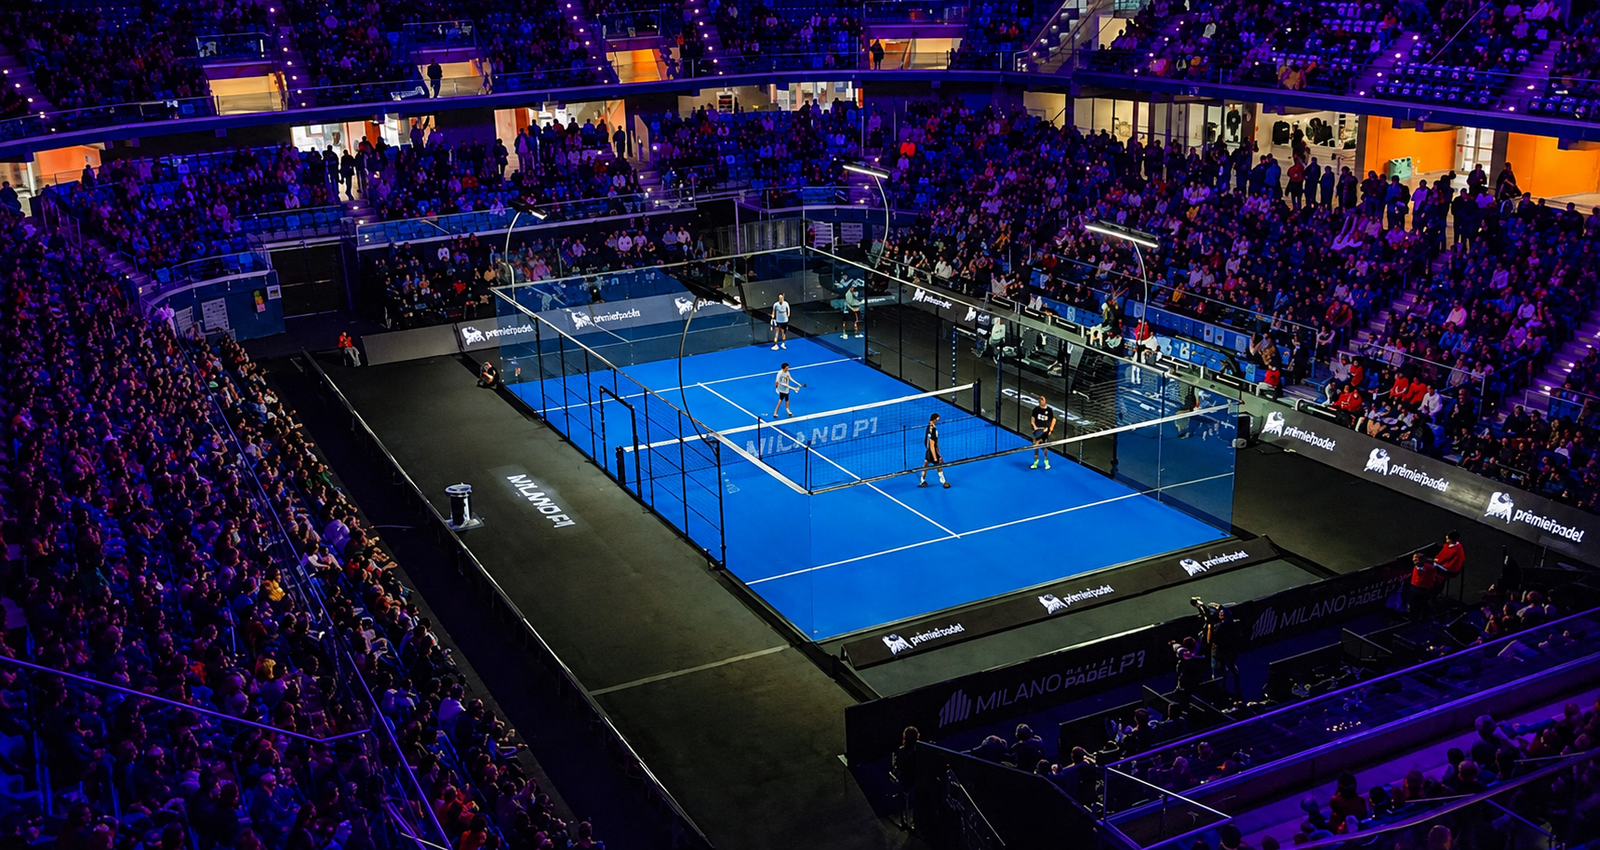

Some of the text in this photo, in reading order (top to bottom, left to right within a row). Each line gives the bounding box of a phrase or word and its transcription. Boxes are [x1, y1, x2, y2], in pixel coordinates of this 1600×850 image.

[852, 416, 879, 438] P1
[1512, 508, 1585, 543] premierpadel
[1280, 595, 1346, 629] MILANO
[1347, 588, 1384, 609] PADEL
[976, 673, 1062, 714] MILANO
[1064, 665, 1118, 690] PADEL
